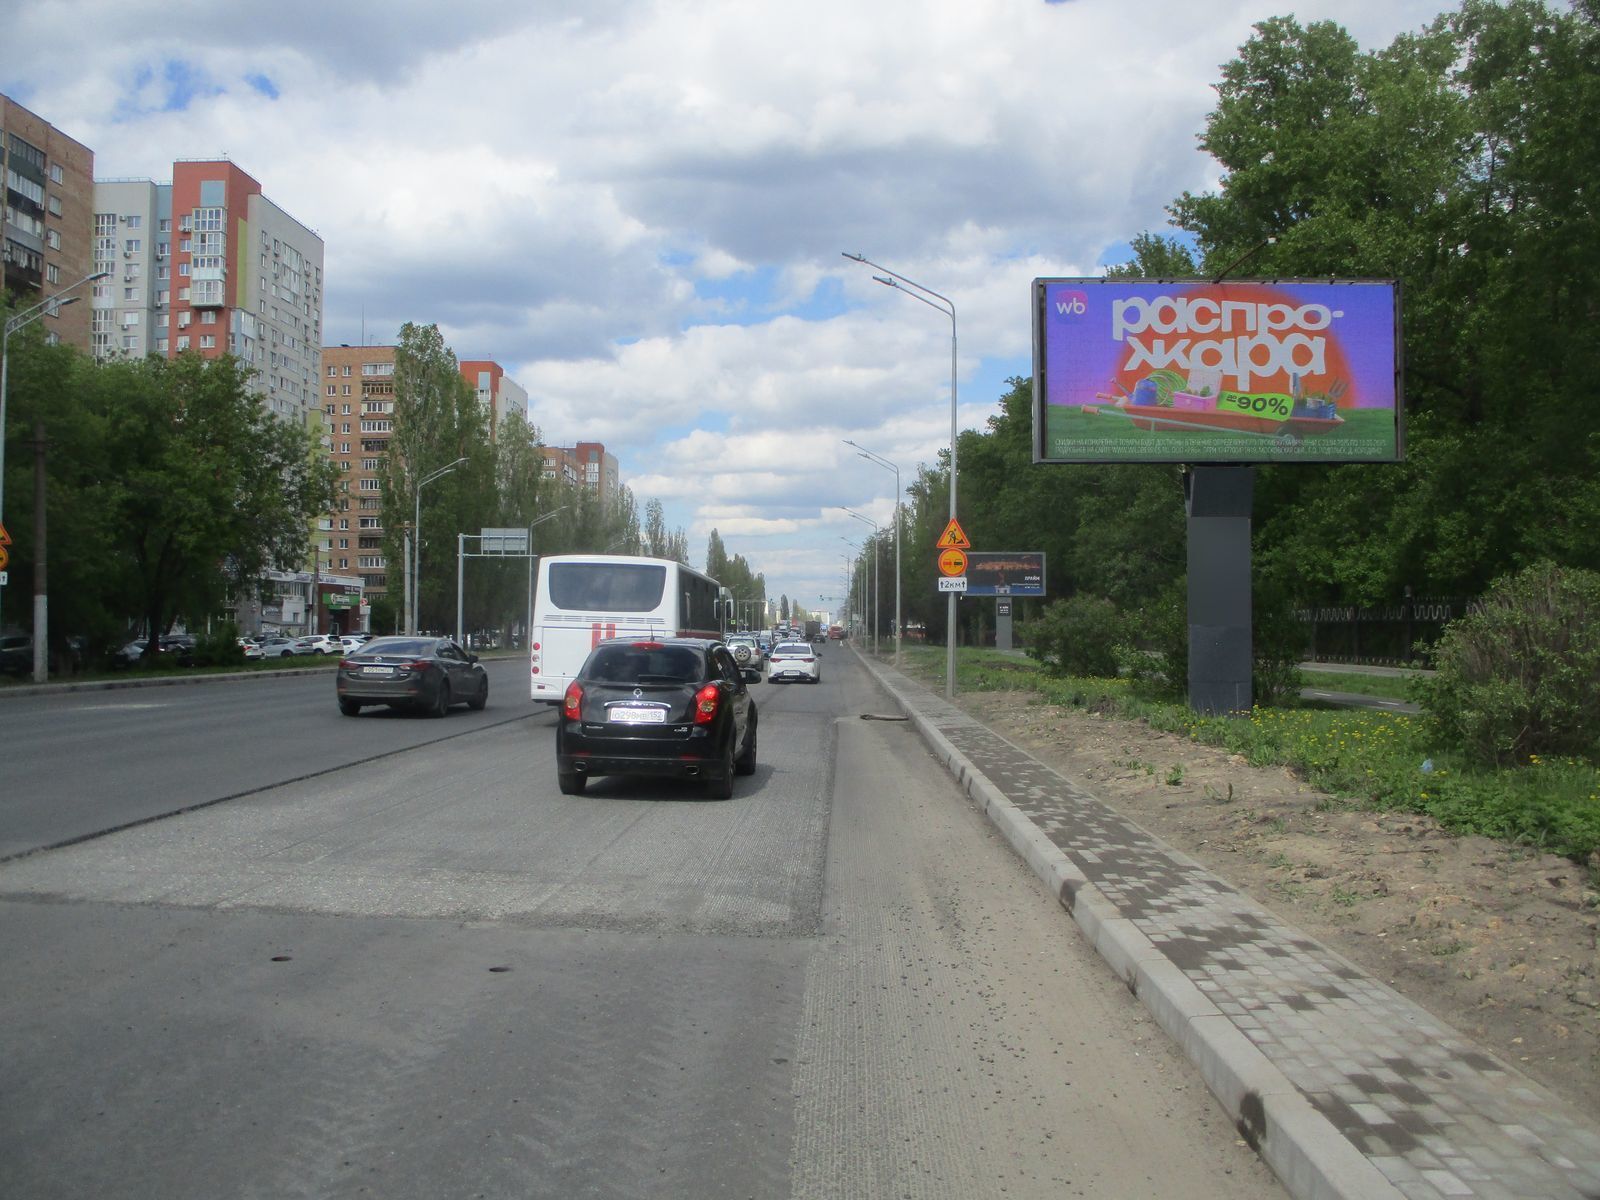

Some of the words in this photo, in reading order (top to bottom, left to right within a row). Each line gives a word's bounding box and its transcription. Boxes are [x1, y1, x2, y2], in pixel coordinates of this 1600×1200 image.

[1056, 297, 1086, 315] wb
[1112, 295, 1345, 341] распро-
[1123, 333, 1326, 393] жара
[1237, 396, 1288, 416] 90%
